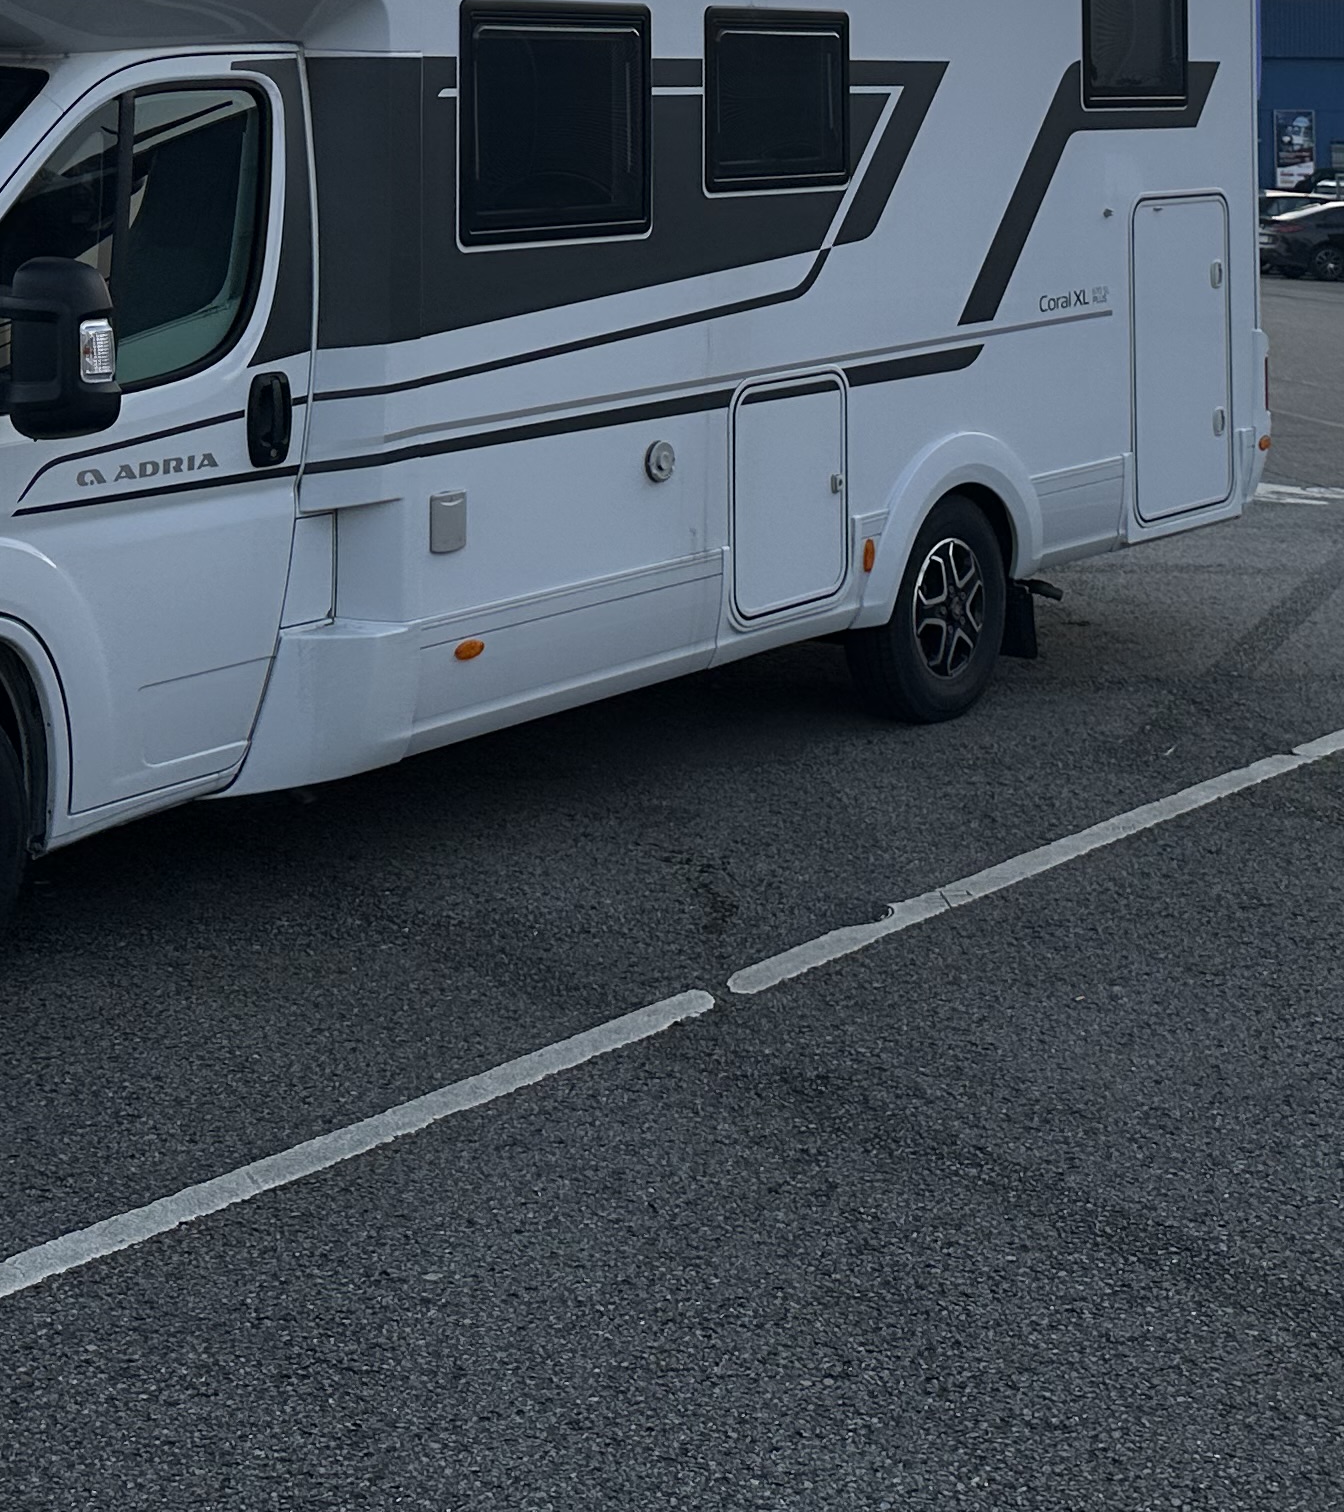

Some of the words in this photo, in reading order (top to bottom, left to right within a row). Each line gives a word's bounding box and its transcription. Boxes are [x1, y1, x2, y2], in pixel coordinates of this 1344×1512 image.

[1039, 290, 1072, 313] Coral
[1073, 289, 1090, 307] XL
[113, 452, 219, 482] ADRIA
